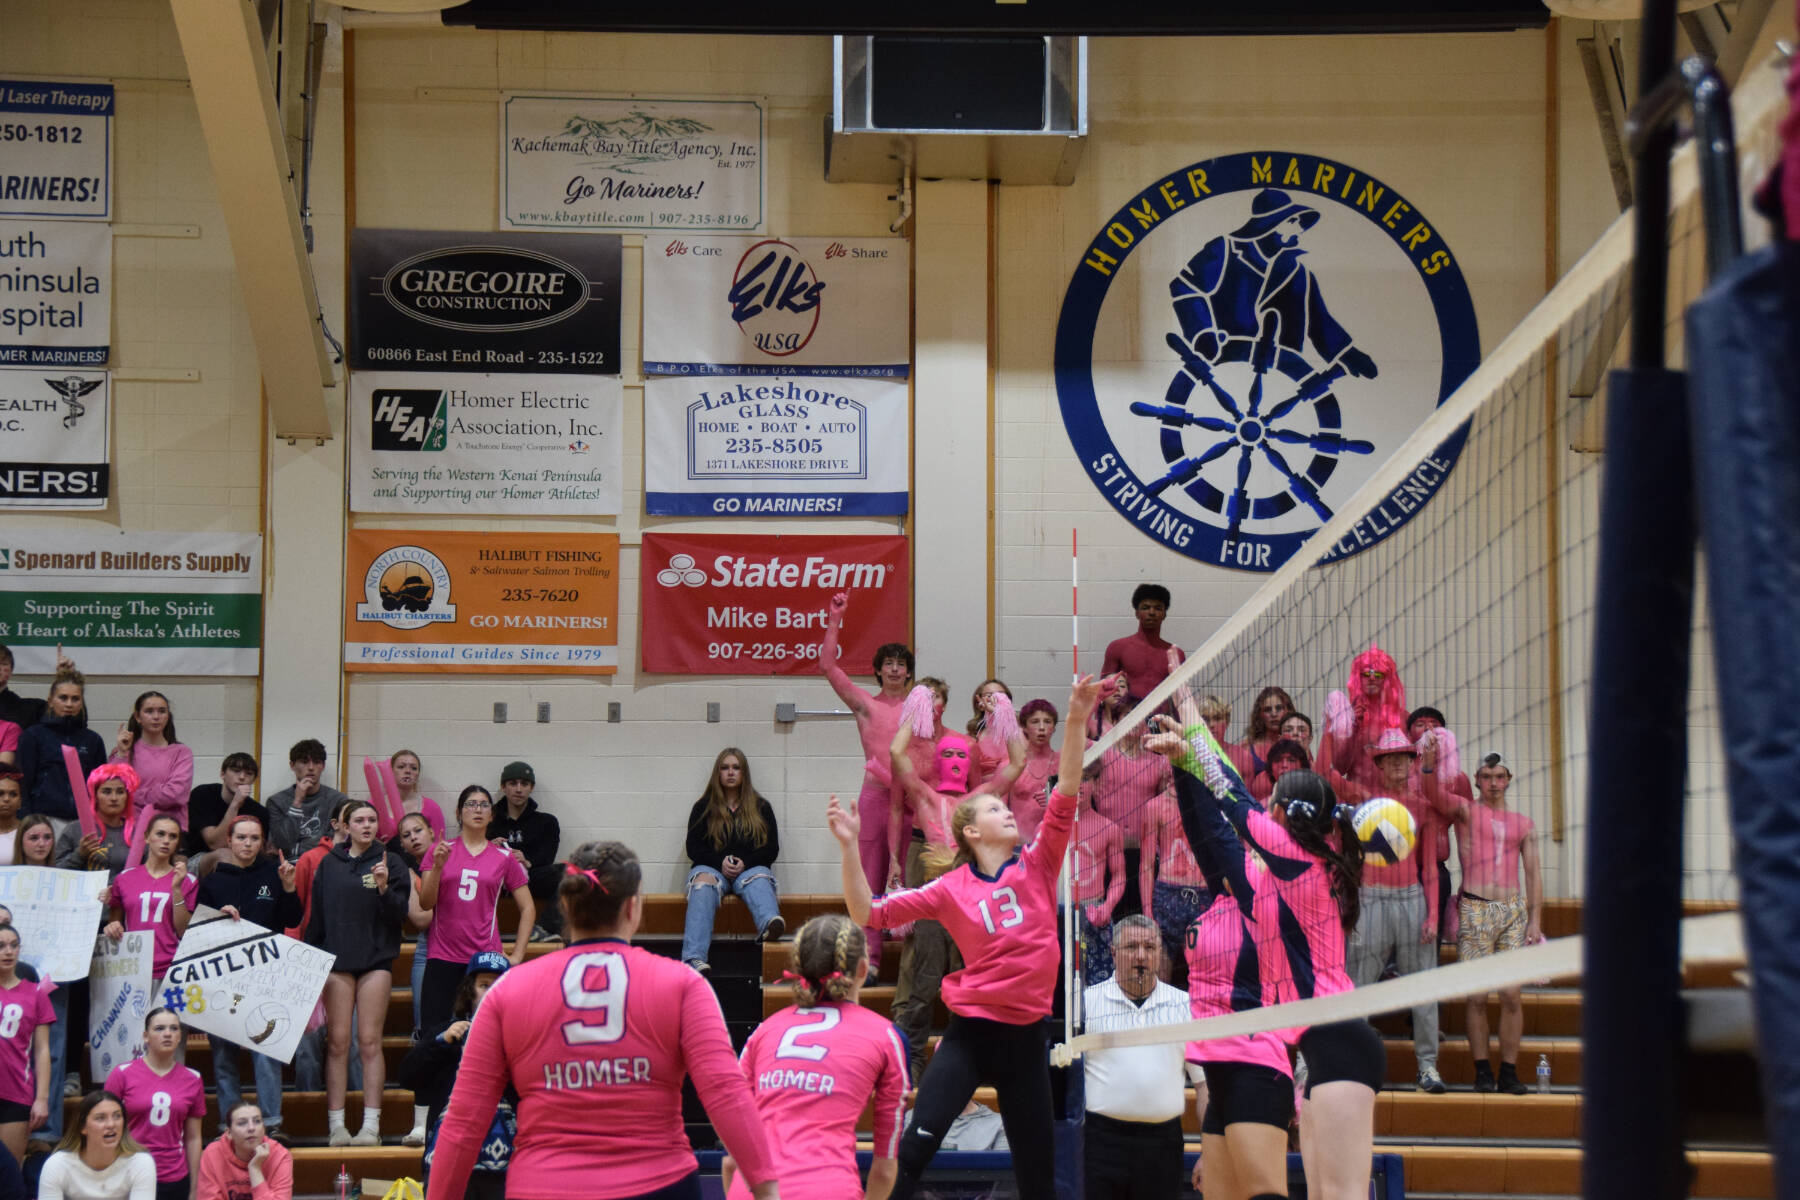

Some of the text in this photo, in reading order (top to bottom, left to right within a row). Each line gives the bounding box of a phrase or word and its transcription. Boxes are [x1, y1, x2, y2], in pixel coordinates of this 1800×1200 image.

[8, 89, 48, 104] Laser
[50, 90, 111, 111] Therapy
[511, 137, 756, 159] Kachemak Bay Title Agency, Inc.
[717, 160, 755, 169] Est. 1977
[0, 175, 99, 202] RINERS!
[564, 175, 705, 205] Go Mariners!
[519, 211, 749, 225] www.kbaytitle.com 907-235-8196
[1085, 156, 1450, 277] HOMER MARINERS
[665, 239, 722, 257] Elks Care
[825, 242, 889, 260] Elks Share
[400, 269, 566, 295] GREGOIRE
[728, 251, 826, 323] Elks
[416, 295, 551, 311] CONSTRUCTION
[0, 302, 83, 335] spital
[754, 332, 801, 351] usa
[31, 351, 106, 363] MARINERS!
[368, 348, 411, 361] 60866
[415, 349, 448, 362] East
[452, 349, 481, 363] End
[485, 350, 524, 364] Road
[538, 351, 604, 365] 235-1522
[729, 366, 741, 374] of
[772, 367, 796, 375] USA
[450, 390, 590, 409] Homer Electric
[699, 381, 850, 411] Lakeshore
[374, 396, 426, 442] HEA
[739, 403, 809, 419] GLASS
[450, 417, 603, 438] Association, Inc.
[698, 423, 856, 434] HOME BOAT AUTO
[726, 438, 823, 454] 235-8505
[706, 460, 849, 470] 1371 LAKESHORE DRIVE
[372, 466, 602, 487] Serving the Western Kenai Peninsula
[373, 484, 600, 504] and Supporting our Homer Athletes!
[713, 498, 843, 512] GO MARINERS!
[1092, 452, 1194, 547] STRIVING
[1219, 539, 1272, 568] FOR
[14, 550, 251, 573] Spenard Builders Supply
[479, 550, 602, 562] HALIBUT FISHING
[367, 550, 448, 590] NORTH COUNTRY
[470, 566, 611, 579] & Saltwater Salmon Trolling
[501, 588, 579, 603] 235-7620
[24, 600, 215, 620] Supporting The Spirit
[405, 612, 452, 620] CHARTERS
[707, 607, 768, 628] Mike
[17, 623, 69, 638] Heart
[73, 622, 93, 638] of
[96, 623, 166, 638] Alaska's
[170, 624, 241, 639] Athletes
[469, 615, 608, 630] GO MARINERS!
[361, 647, 602, 660] Professional Guides Since 1979
[458, 868, 479, 901] 5
[139, 892, 170, 923] 17
[977, 886, 1025, 935] 13
[169, 938, 281, 984] CAITLYN
[163, 984, 206, 1014] #8
[561, 952, 630, 1046] 9
[91, 981, 132, 1050] CHANNING
[775, 1005, 842, 1062] 2
[543, 1056, 651, 1091] HOMER
[758, 1068, 836, 1096] HOMER
[149, 1091, 172, 1127] 8
